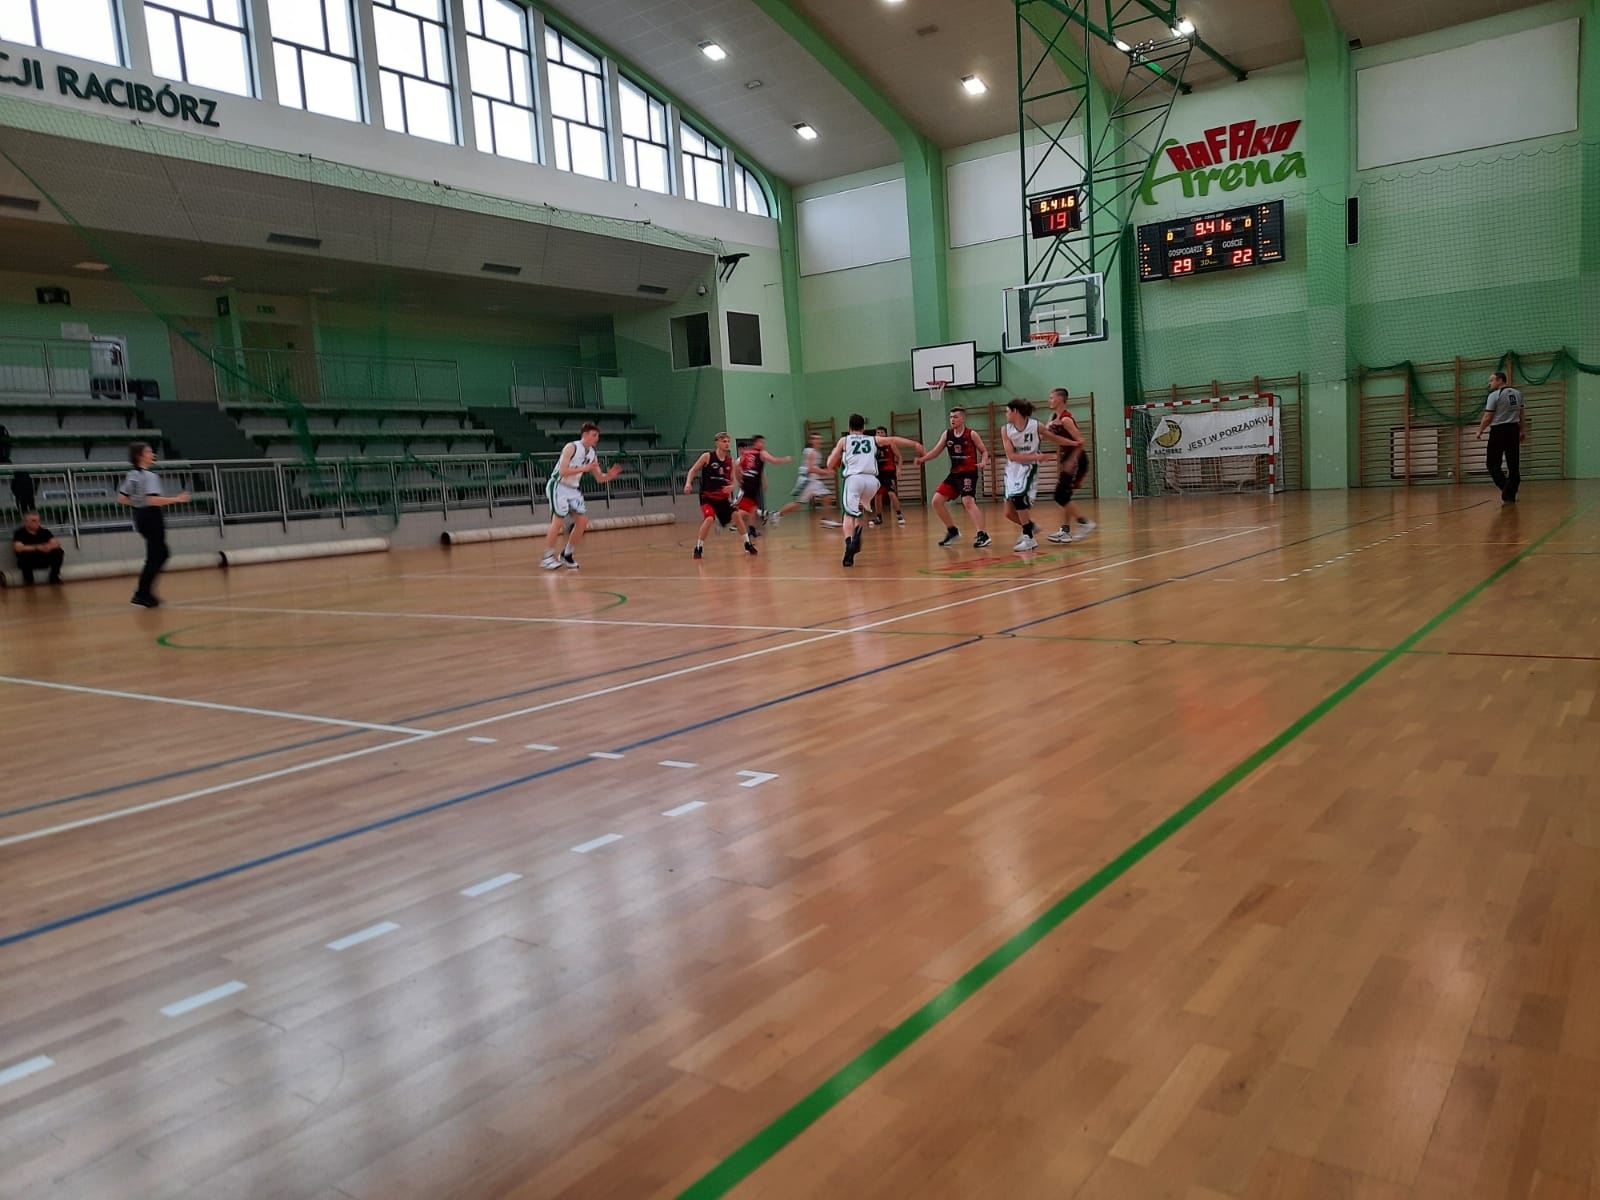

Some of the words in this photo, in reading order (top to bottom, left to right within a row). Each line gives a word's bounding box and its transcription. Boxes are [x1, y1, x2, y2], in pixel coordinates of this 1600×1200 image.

[57, 65, 220, 128] RACIBÓRZ
[1131, 138, 1307, 205] Arena
[1050, 212, 1067, 230] 19
[1233, 248, 1252, 264] 22
[1173, 258, 1192, 273] 29
[851, 439, 871, 455] 23
[1187, 436, 1208, 451] JEST
[1208, 433, 1218, 442] W
